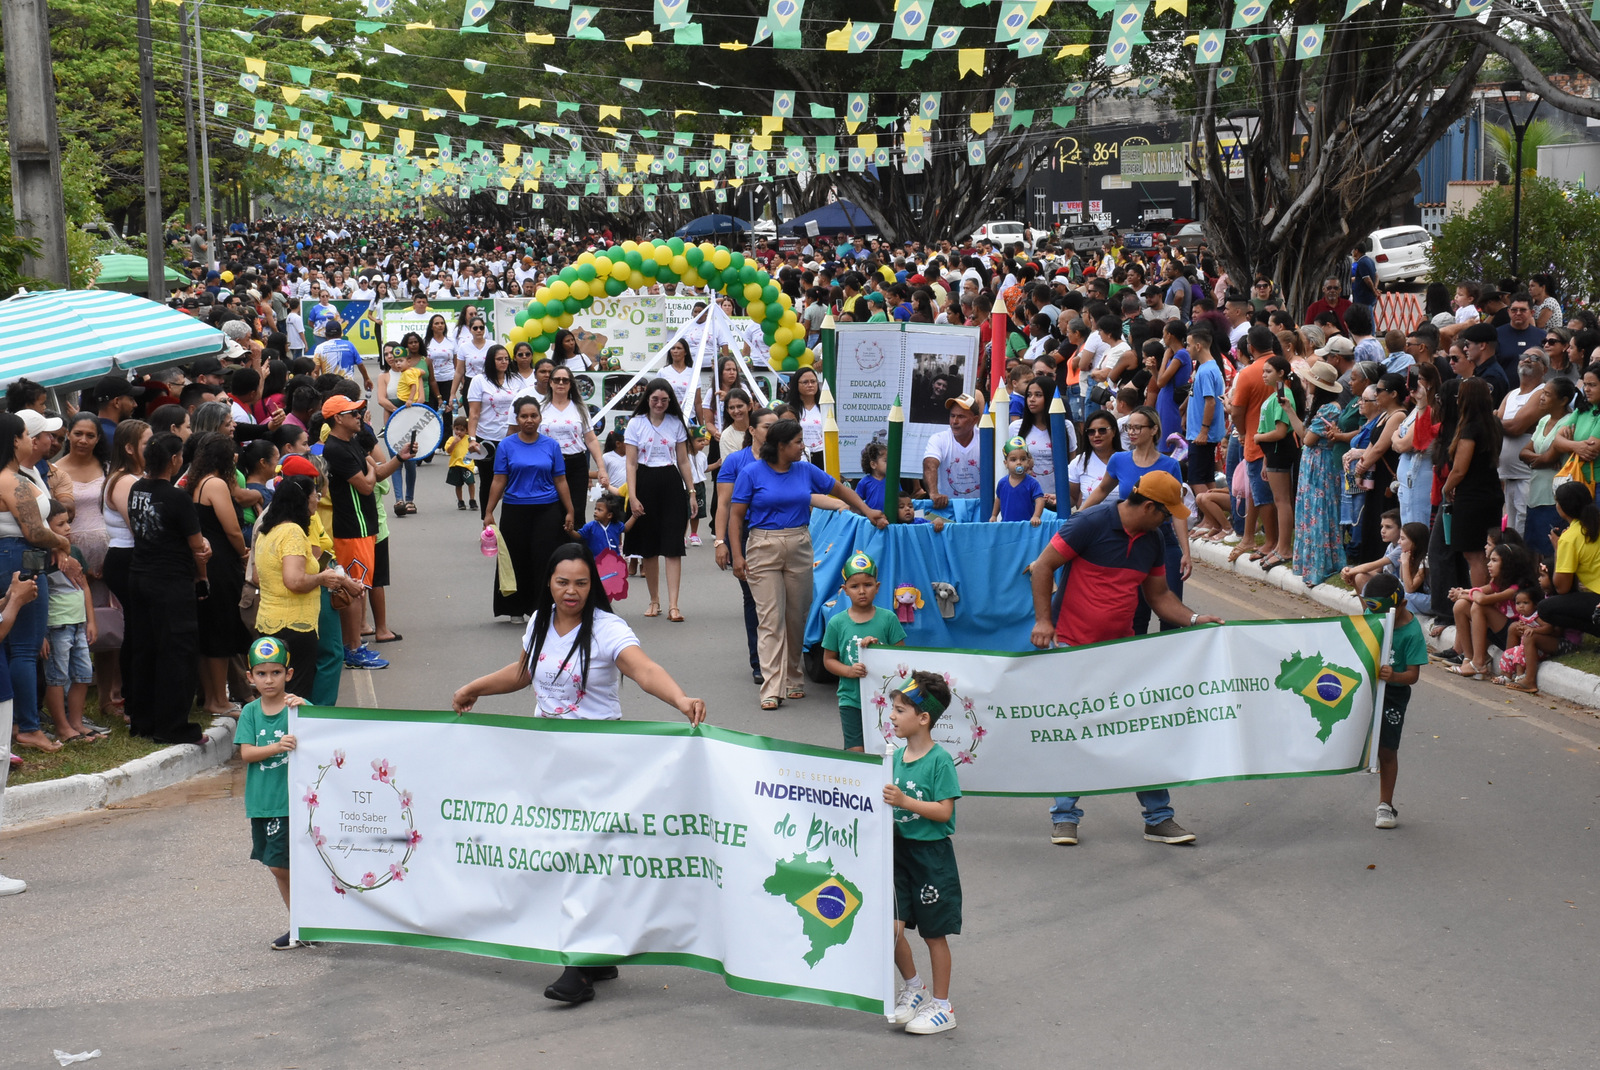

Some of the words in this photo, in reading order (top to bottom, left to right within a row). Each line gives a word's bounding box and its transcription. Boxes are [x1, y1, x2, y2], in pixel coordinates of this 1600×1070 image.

[1093, 142, 1118, 161] 364
[1142, 152, 1156, 174] DOIS
[1158, 147, 1183, 174] IRMÃOS
[850, 380, 886, 388] EDUCAÇÃO
[132, 496, 150, 511] BTS
[1010, 697, 1105, 719] EDUCAÇÃO
[1109, 692, 1119, 710] É
[1123, 694, 1135, 707] O
[1139, 687, 1194, 705] ÚNICO
[1198, 678, 1270, 695] CAMINHO
[1030, 728, 1077, 742] PARA
[1081, 726, 1093, 739] A
[778, 768, 791, 777] 07
[796, 771, 806, 779] DE
[811, 773, 861, 787] SETEMBRO
[352, 791, 372, 804] TST
[754, 781, 874, 813] INDEPENDÊNCIA
[340, 811, 360, 821] Todo
[362, 812, 387, 822] Saber
[440, 799, 508, 824] CENTRO
[511, 805, 638, 834] ASSISTENCIAL
[642, 814, 656, 836] E
[663, 814, 748, 847] CRECHE
[339, 823, 387, 834] Transforma
[774, 813, 797, 839] do
[806, 812, 858, 857] Brasil
[456, 837, 504, 868] TÂNIA
[508, 847, 613, 876] SACCOMAN
[618, 855, 723, 889] TORRENTE
